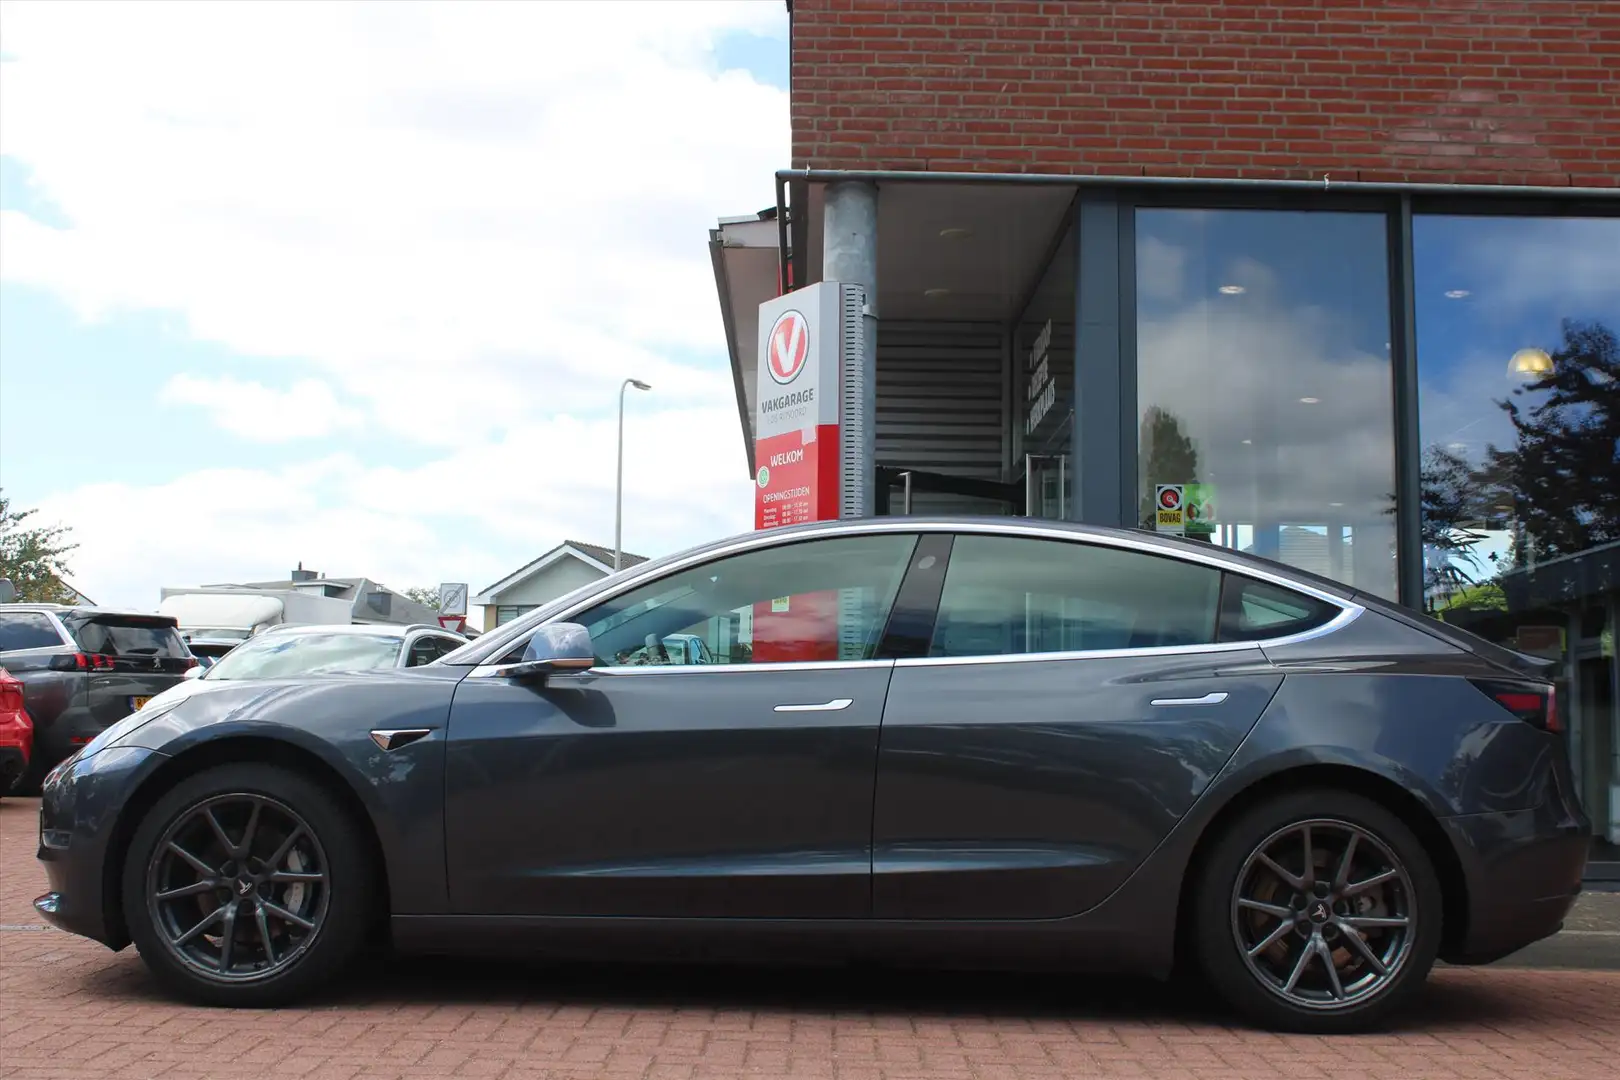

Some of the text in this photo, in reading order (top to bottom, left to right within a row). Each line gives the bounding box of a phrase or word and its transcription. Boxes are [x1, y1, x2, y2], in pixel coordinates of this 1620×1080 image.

[761, 388, 814, 414] VAKGARAGE
[770, 449, 804, 467] WELKOM
[763, 486, 810, 504] OPENINGSTIJDEN
[1159, 512, 1181, 523] BOVAG
